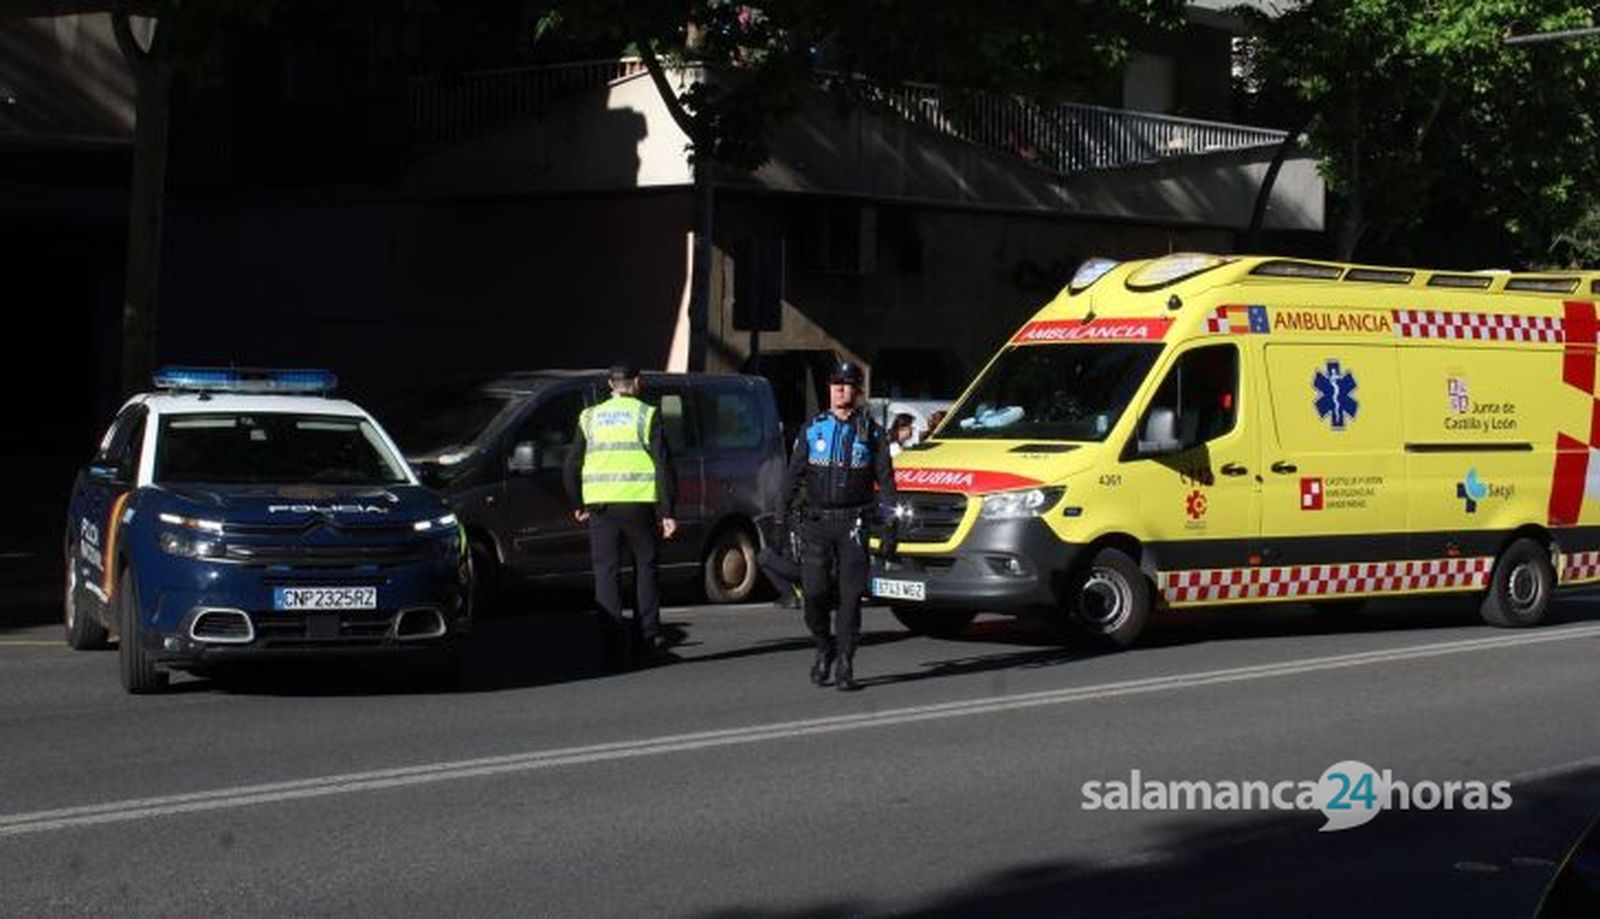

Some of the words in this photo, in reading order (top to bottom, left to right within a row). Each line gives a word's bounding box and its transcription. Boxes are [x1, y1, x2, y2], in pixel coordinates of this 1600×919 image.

[1274, 311, 1391, 332] AMBULANCIA
[1023, 325, 1148, 339] AMBULANCIA
[1472, 401, 1500, 414] Junta
[1503, 402, 1516, 414] de
[1444, 417, 1482, 430] Castilla
[1483, 420, 1490, 433] y
